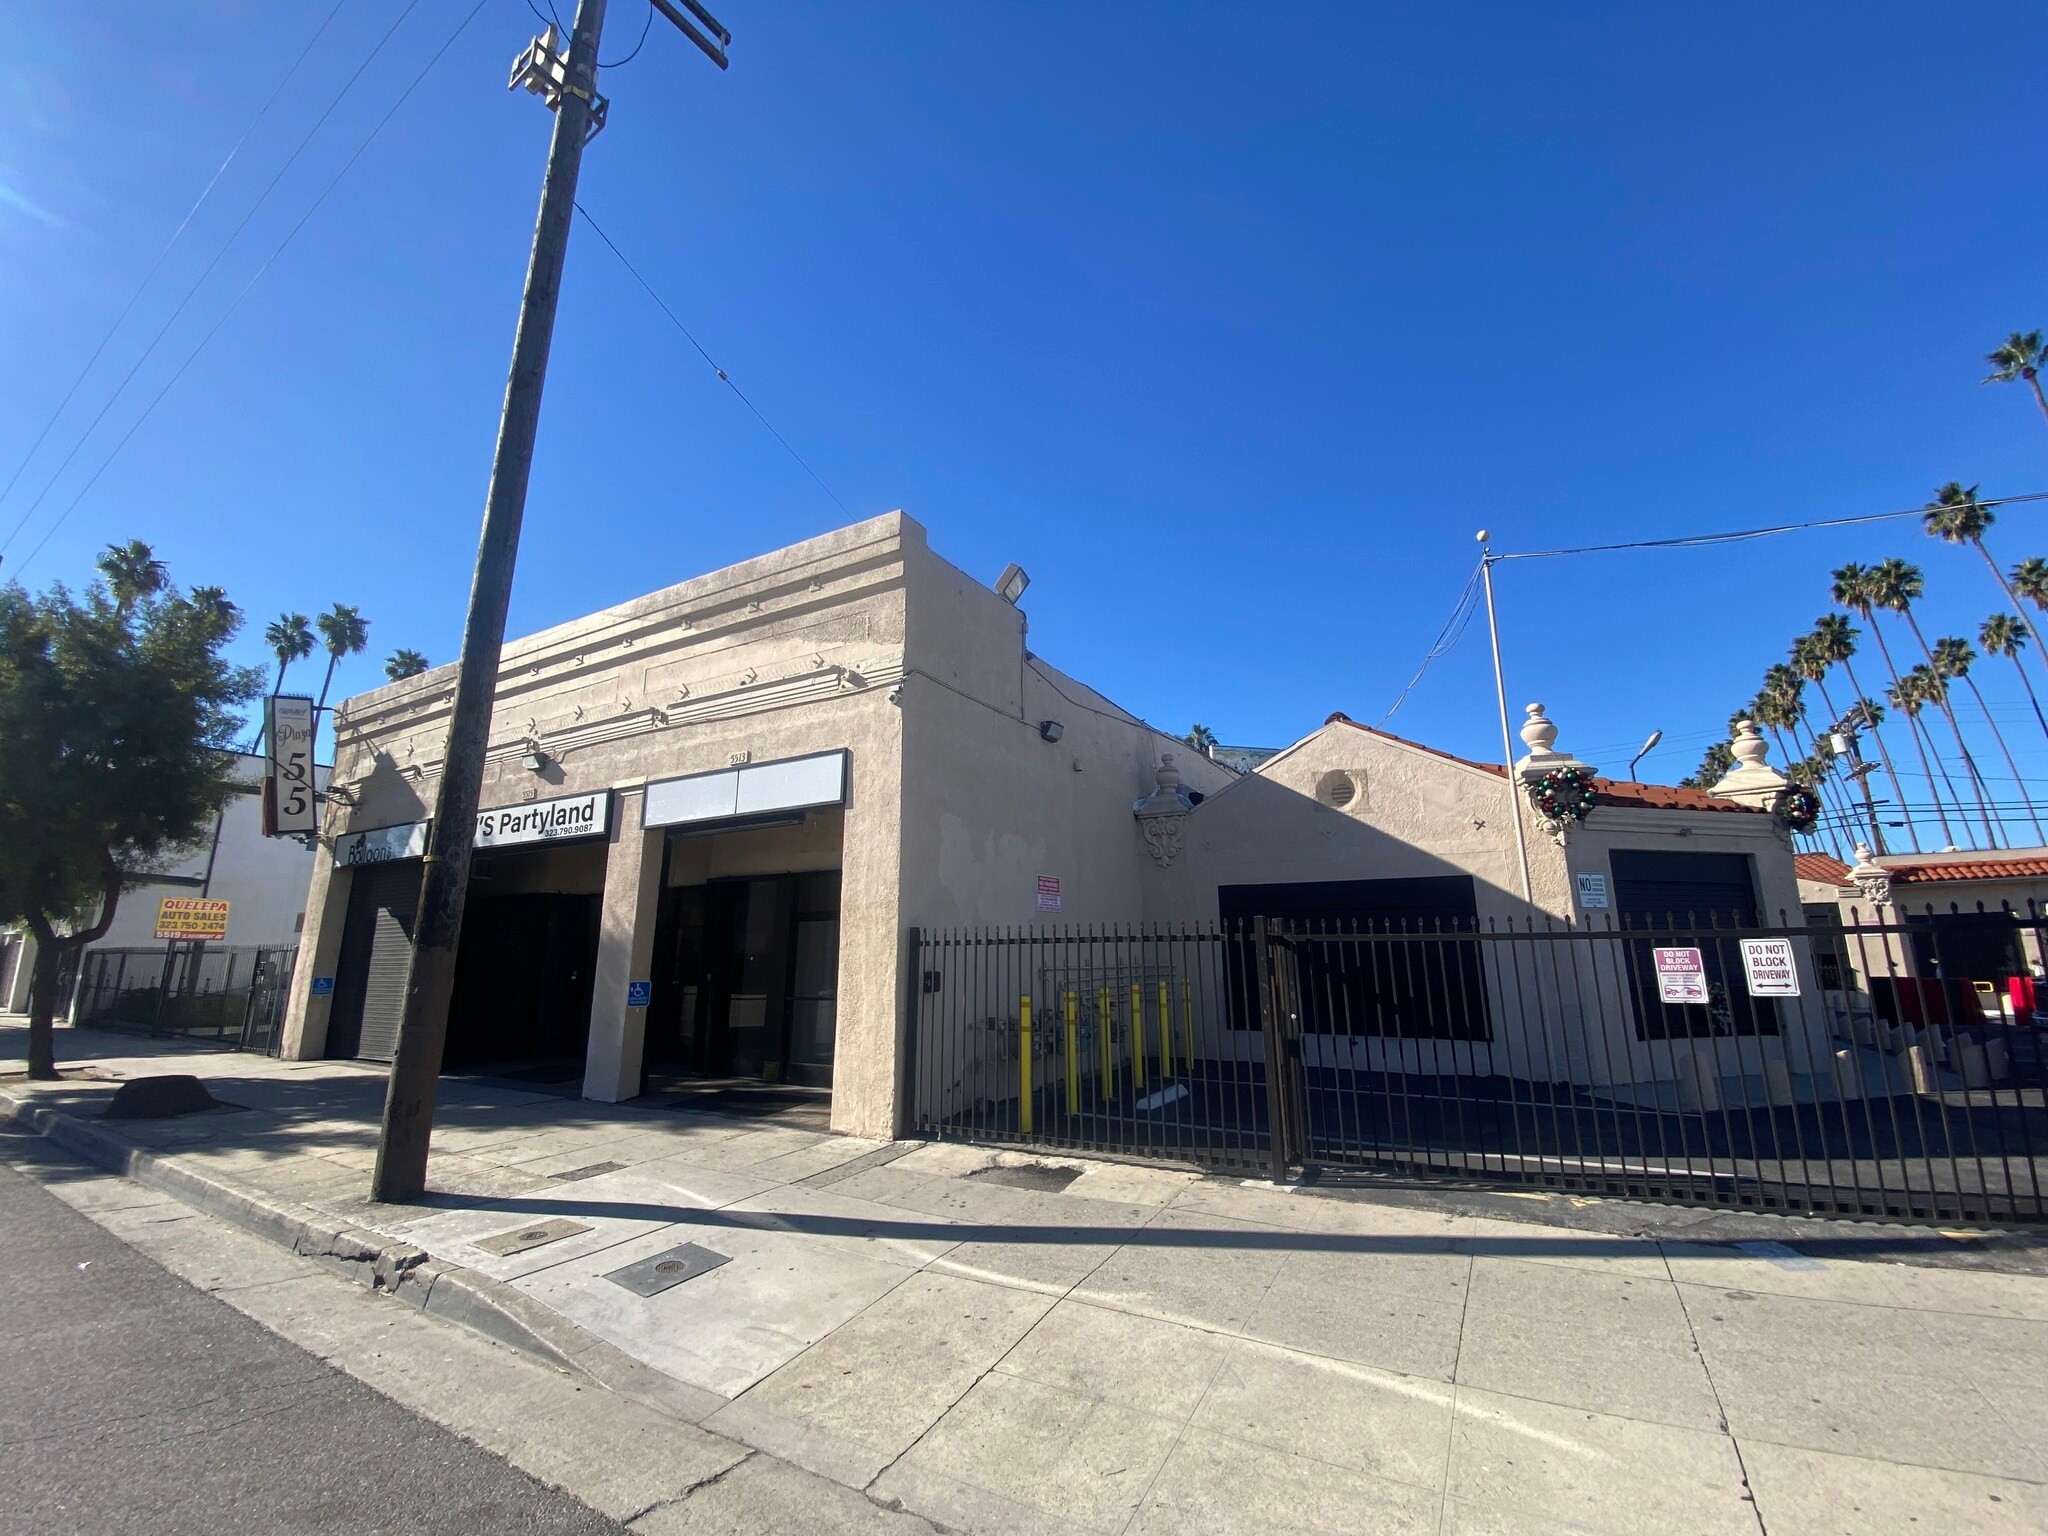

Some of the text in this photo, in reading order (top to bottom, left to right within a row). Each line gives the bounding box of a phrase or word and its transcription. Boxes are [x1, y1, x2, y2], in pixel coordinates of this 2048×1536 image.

[276, 724, 312, 746] Plaza
[499, 797, 595, 835] Partyland
[544, 823, 593, 837] 323.790.9087
[348, 844, 392, 865] Balloons
[1578, 877, 1592, 892] NO
[164, 900, 228, 912] QUELEPA
[161, 911, 227, 921] AUTO SALES
[156, 931, 181, 939] 5519
[1663, 950, 1690, 958] DO NOT
[1749, 944, 1785, 955] DO NOT
[1752, 957, 1787, 967] BLOCK
[1752, 969, 1791, 980] DRIVEWAY
